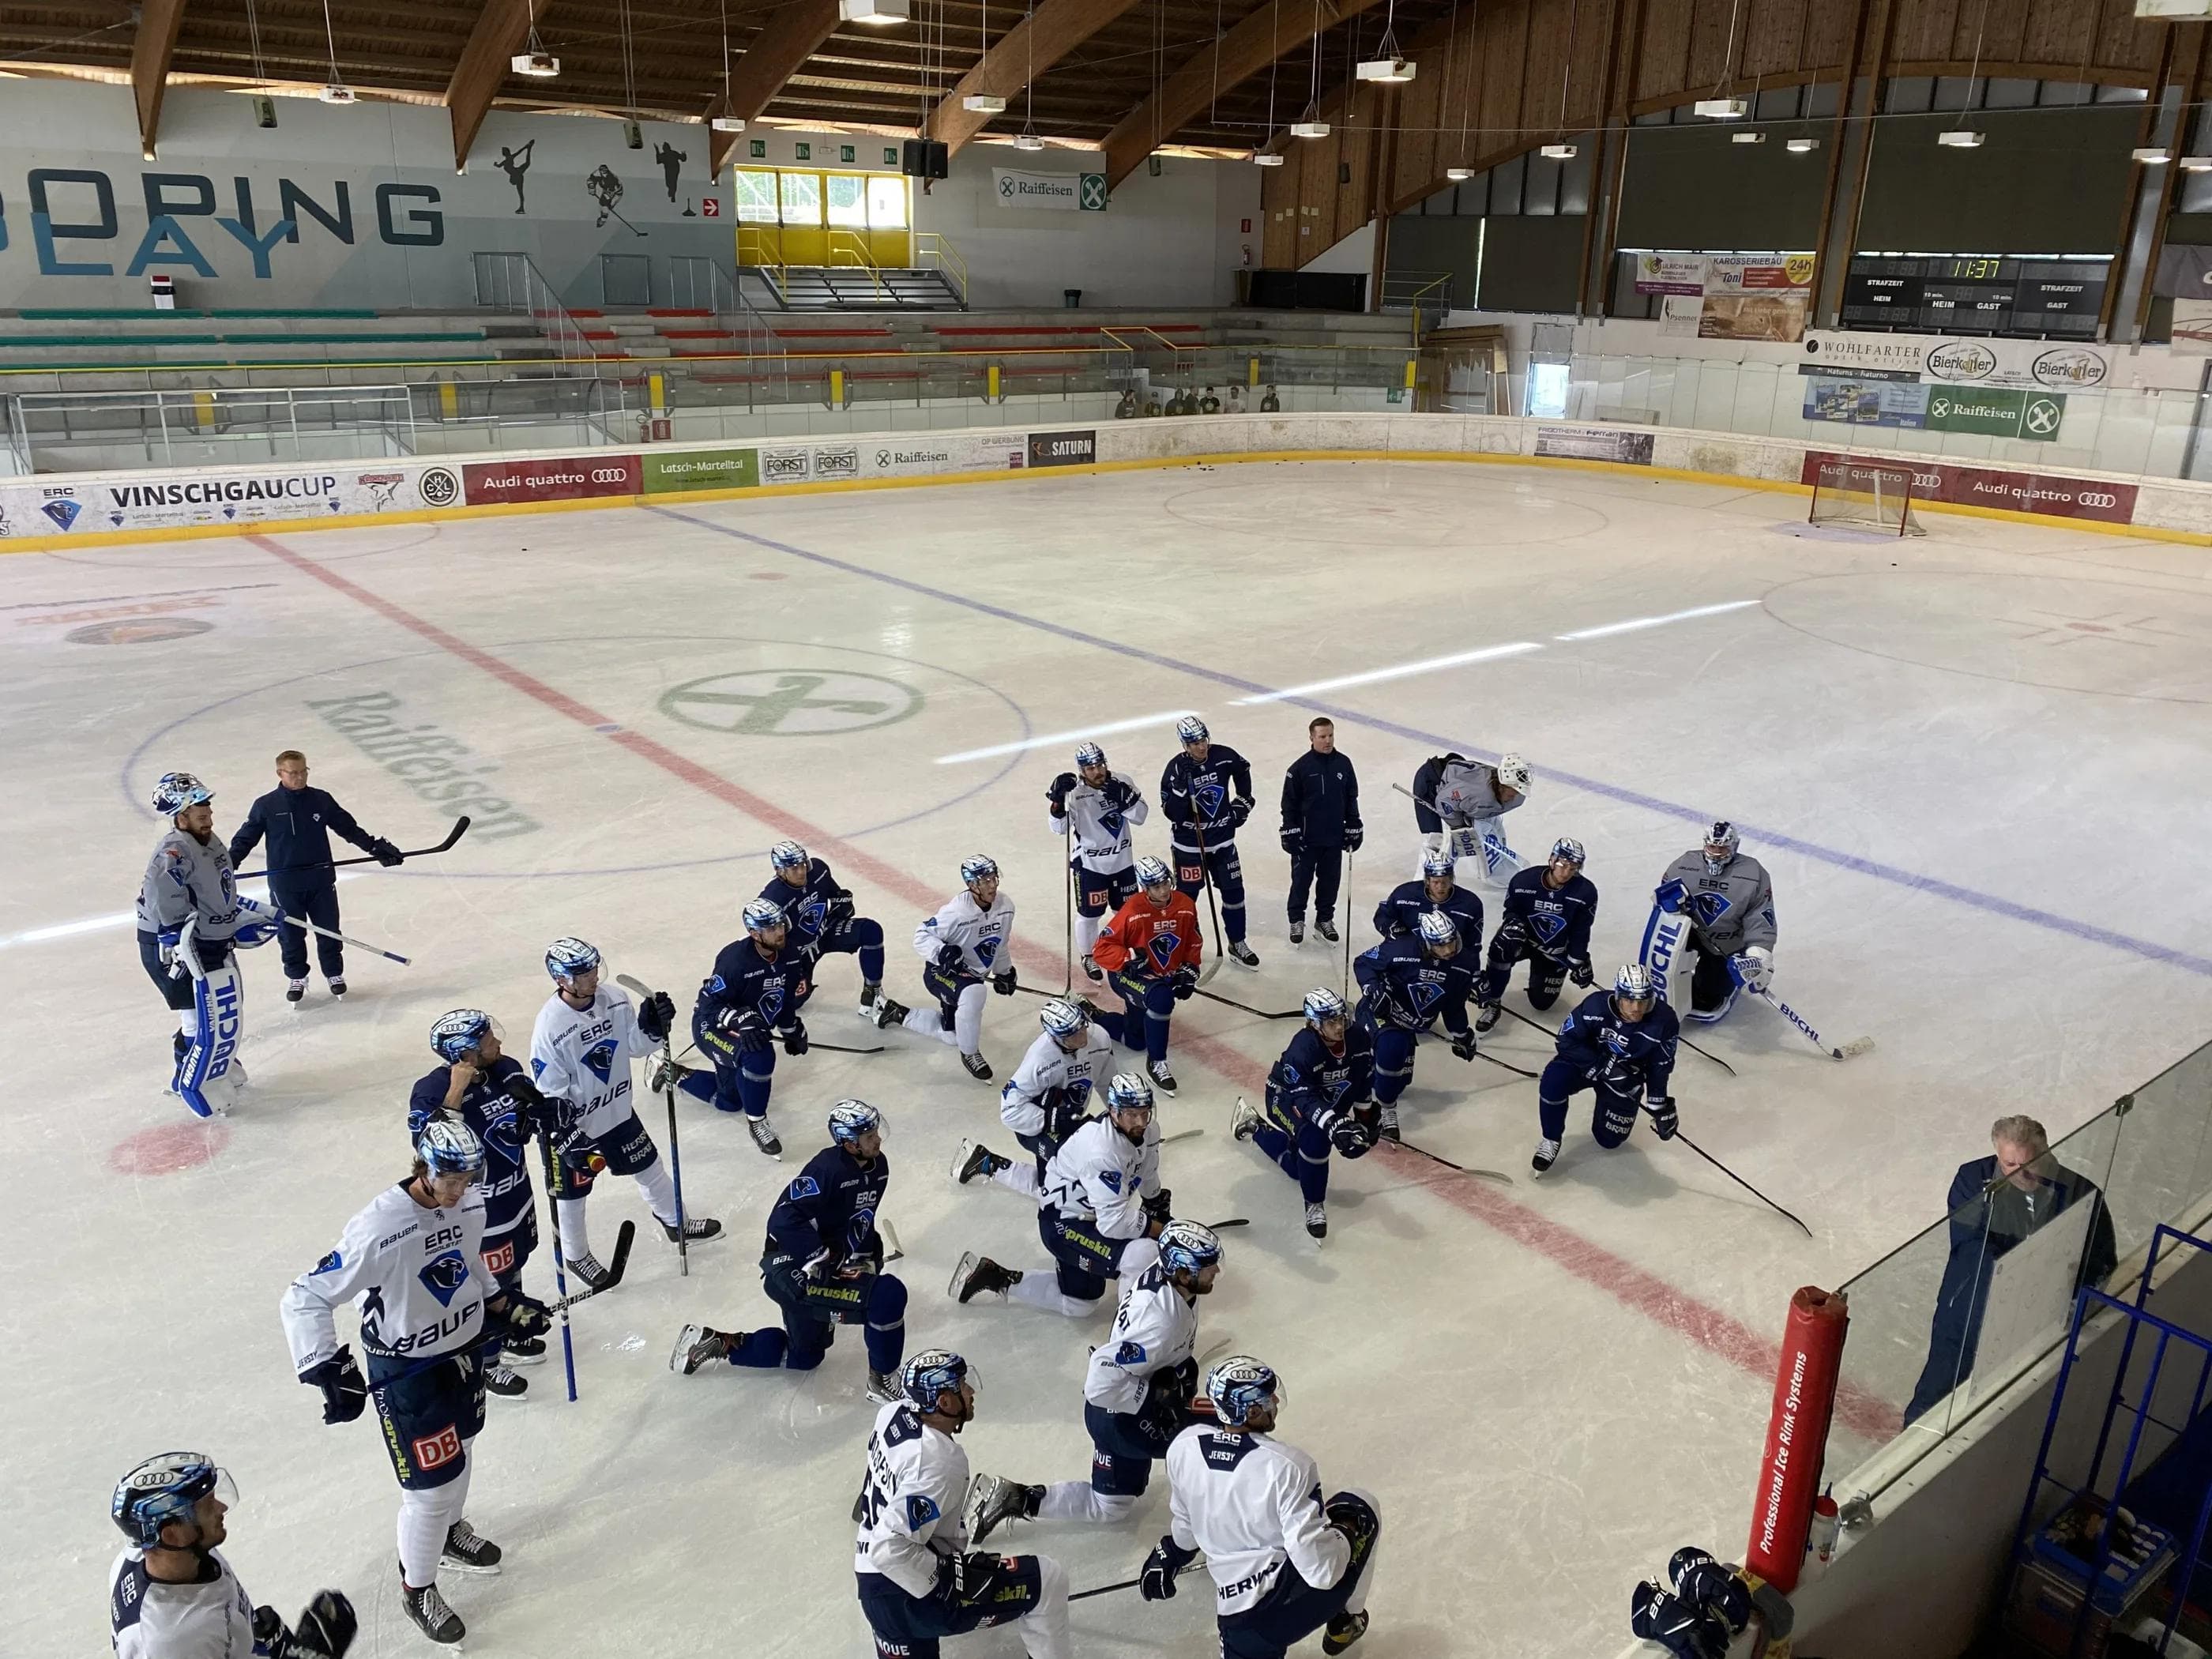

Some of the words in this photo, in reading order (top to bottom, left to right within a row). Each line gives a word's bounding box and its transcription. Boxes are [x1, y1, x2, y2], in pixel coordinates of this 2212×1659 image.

[1018, 181, 1073, 196] Raiffeisen
[0, 168, 444, 246] OPING
[0, 212, 296, 279] LAY
[1714, 257, 1782, 265] KAROSSERIEBAU
[1790, 259, 1811, 271] 24h
[1954, 260, 1999, 278] 11:37
[1721, 272, 1742, 283] Toni
[1867, 279, 1904, 288] STRAFZEIT
[2041, 284, 2084, 293] STRAFZEIT
[1932, 300, 1955, 309] HEIM
[1977, 302, 2001, 311] GAST
[1824, 341, 1920, 357] WOHLFARTER
[1827, 368, 1853, 377] Naturns
[1860, 370, 1889, 379] Naturno
[1953, 404, 2015, 419] Raiffeisen
[991, 436, 1025, 445] WERBUNG
[1052, 440, 1092, 456] SATURN
[767, 457, 804, 472] FORST
[818, 455, 854, 469] FORST
[894, 451, 948, 464] Raiffeisen
[660, 459, 743, 474] Latsch-Martelltal
[483, 474, 520, 489] Audi
[525, 472, 585, 487] quattro
[1851, 468, 1902, 482] quatro
[43, 487, 74, 496] ERC
[110, 476, 336, 508] VINSCHGAUCUP
[1973, 480, 2008, 496] Audi
[2012, 485, 2071, 502] quattro
[303, 690, 545, 844] Raiffeisen
[1193, 772, 1218, 785] ERC
[1185, 868, 1201, 880] DB
[1698, 878, 1729, 890] ERC
[797, 891, 818, 910] ERC
[1092, 890, 1108, 905] DB
[1534, 899, 1563, 912] ERC
[979, 922, 1001, 935] ERC
[1153, 920, 1177, 930] ERC
[1419, 969, 1446, 980] ERC
[553, 1024, 578, 1047] BAUER
[580, 1020, 613, 1040] ERC
[1601, 1027, 1629, 1045] ERC
[1036, 1059, 1062, 1076] BAUER
[1067, 1062, 1092, 1076] ERC
[1322, 1066, 1350, 1080] ERC
[480, 1093, 514, 1116] ERC
[856, 1191, 877, 1204] ERC
[380, 1224, 418, 1250] BAUER
[425, 1225, 463, 1251] ERC
[487, 1246, 513, 1271] DB
[1785, 1350, 1808, 1413] Systems
[1213, 1432, 1242, 1443] ERC
[1779, 1414, 1796, 1446] Rink
[419, 1428, 458, 1465] DB
[1774, 1447, 1789, 1472] Ice
[1759, 1469, 1785, 1555] Professional
[124, 1572, 137, 1604] ERC
